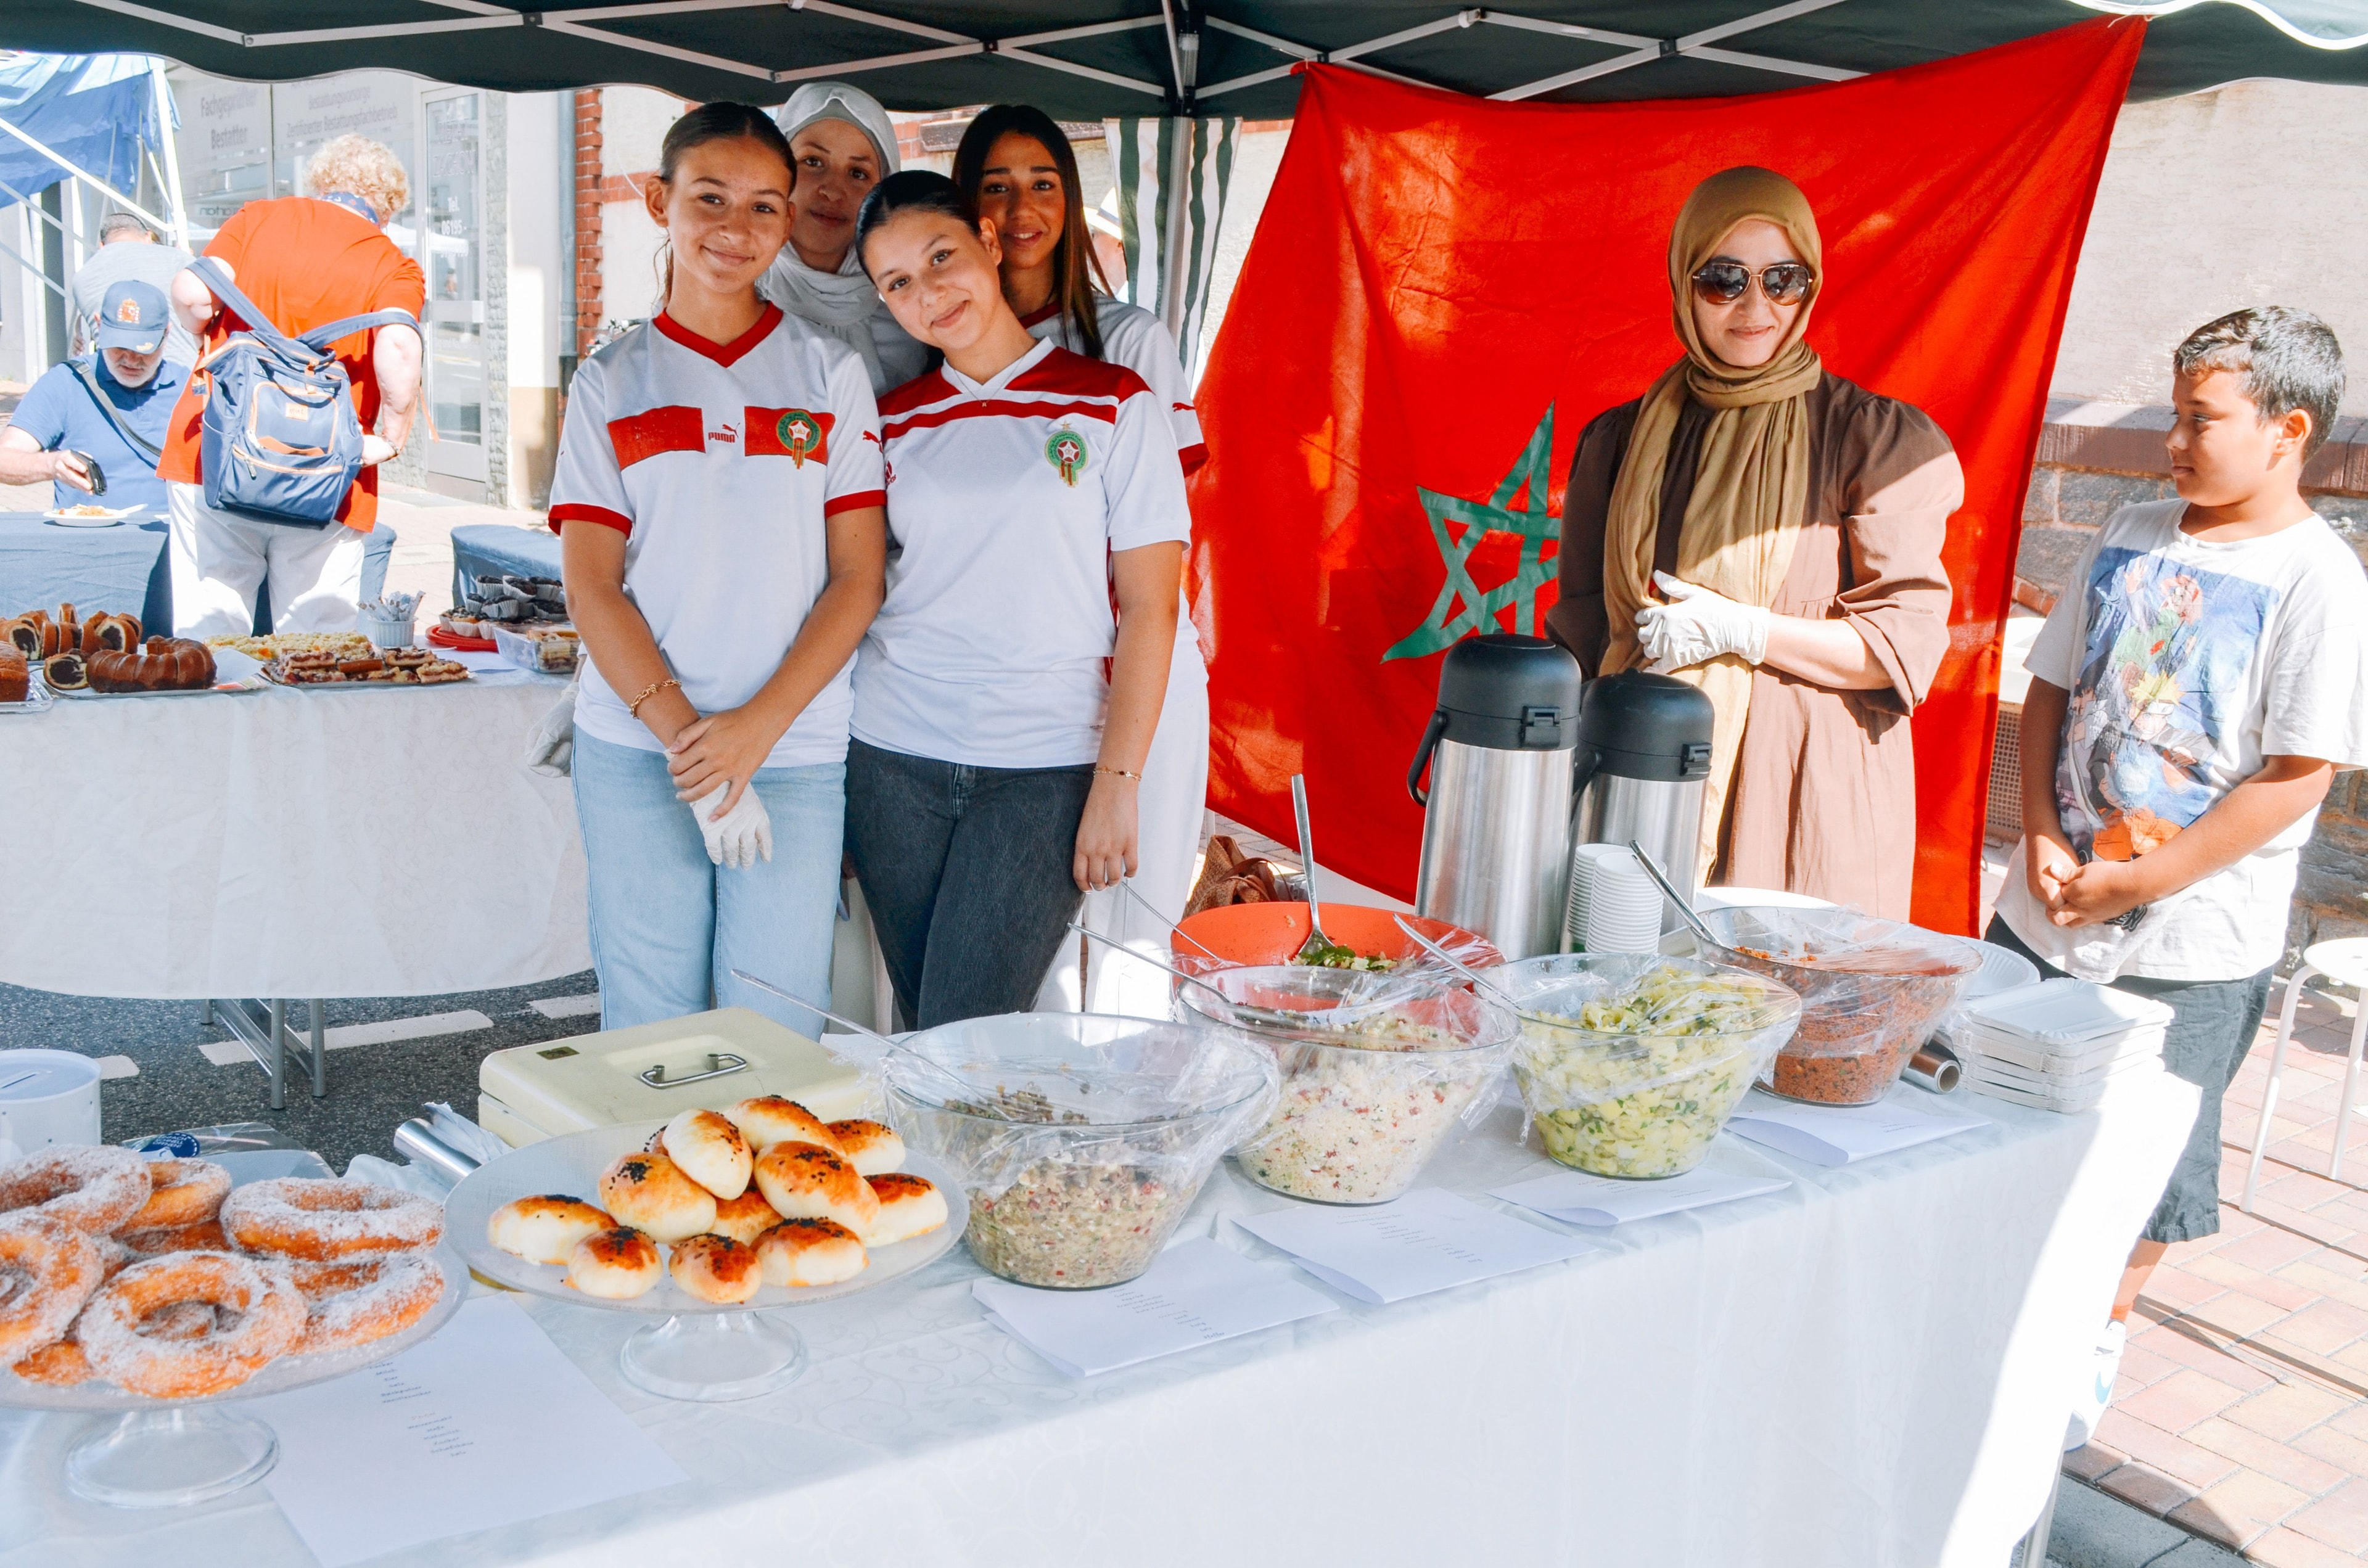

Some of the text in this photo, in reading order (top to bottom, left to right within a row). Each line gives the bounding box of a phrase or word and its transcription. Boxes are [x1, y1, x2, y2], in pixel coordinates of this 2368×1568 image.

[212, 124, 248, 149] Bestatter
[448, 196, 460, 213] Tel.
[708, 432, 735, 443] PUMA
